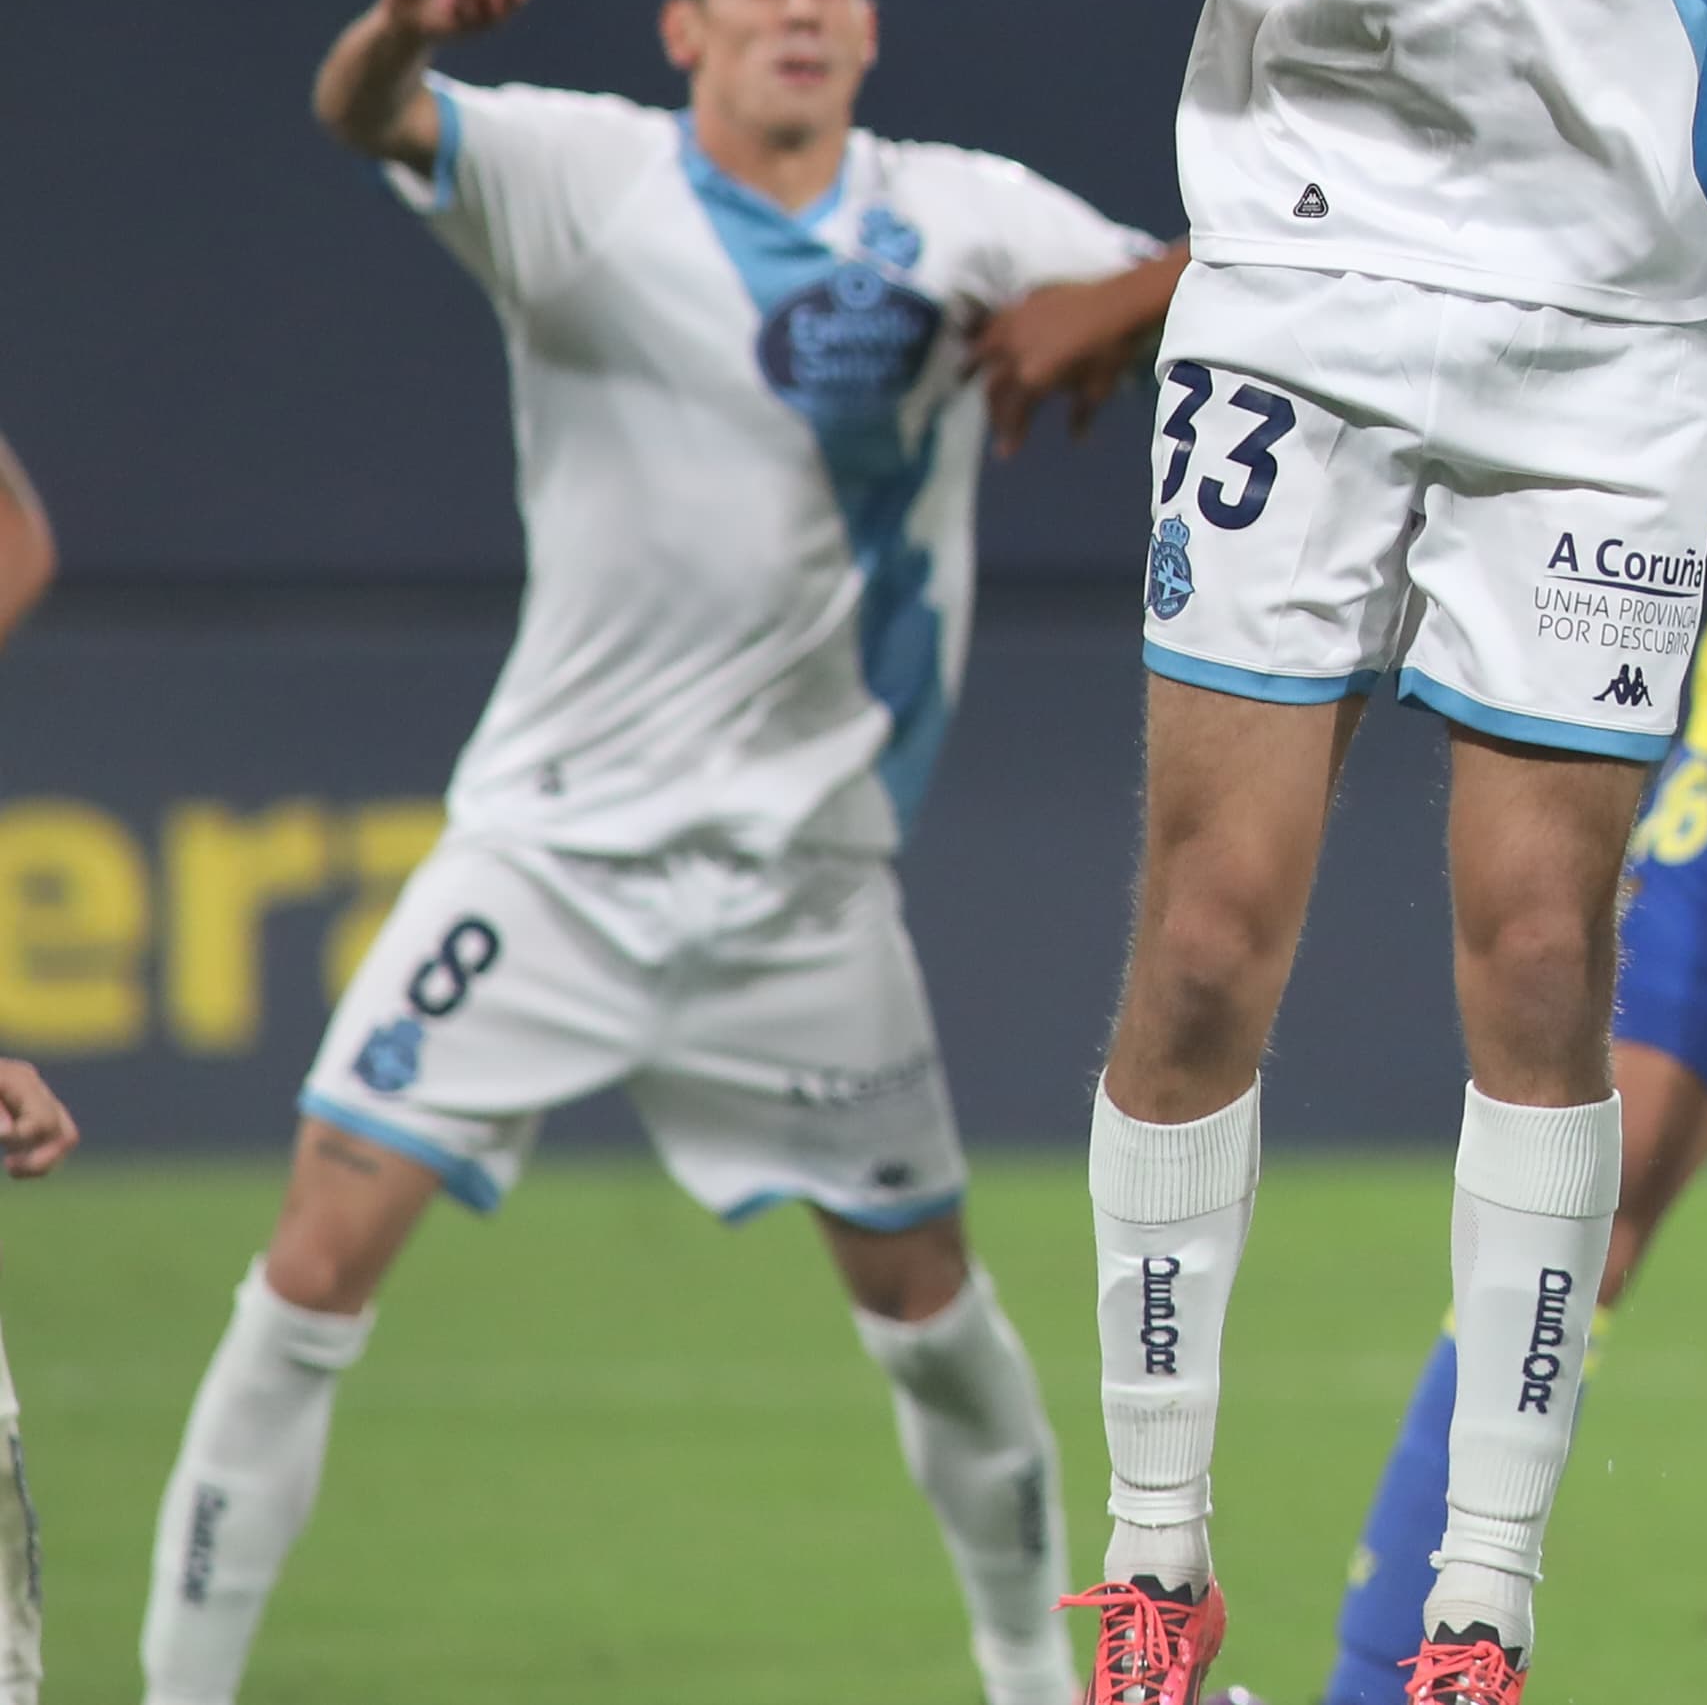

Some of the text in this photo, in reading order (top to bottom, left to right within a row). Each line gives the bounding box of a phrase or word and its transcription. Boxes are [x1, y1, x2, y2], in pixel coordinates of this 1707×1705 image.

[1160, 359, 1297, 531] 33
[1535, 586, 1610, 620] UNHA
[1547, 532, 1704, 589] A Coruña
[1538, 614, 1591, 644] POR
[407, 915, 500, 1017] 8
[1140, 1255, 1181, 1375] DEPOR
[1516, 1267, 1573, 1415] DEPOR
